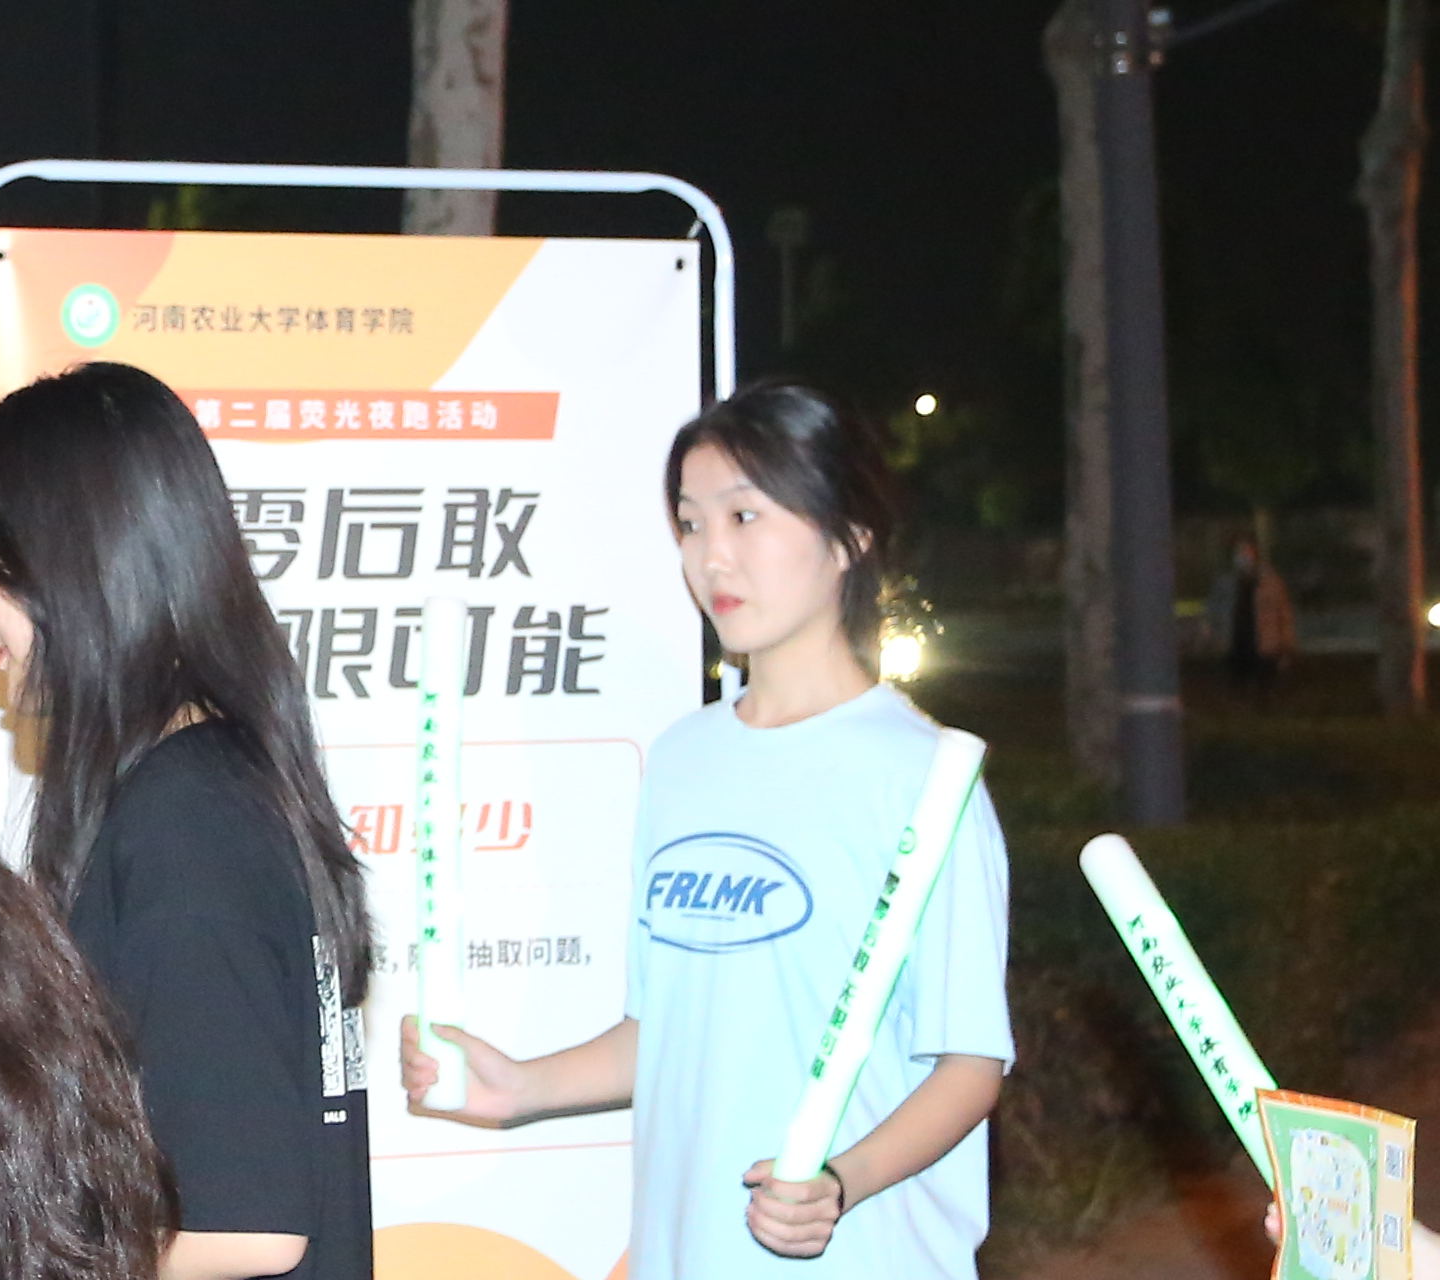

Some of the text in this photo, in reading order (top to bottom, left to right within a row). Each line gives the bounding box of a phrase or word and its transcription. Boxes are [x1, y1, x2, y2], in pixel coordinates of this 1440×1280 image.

[131, 303, 415, 335] 河南农业大学体育学院
[193, 398, 498, 430] 第二届荧光夜跑活动
[348, 800, 534, 855] 知少
[646, 871, 784, 916] FRLMK
